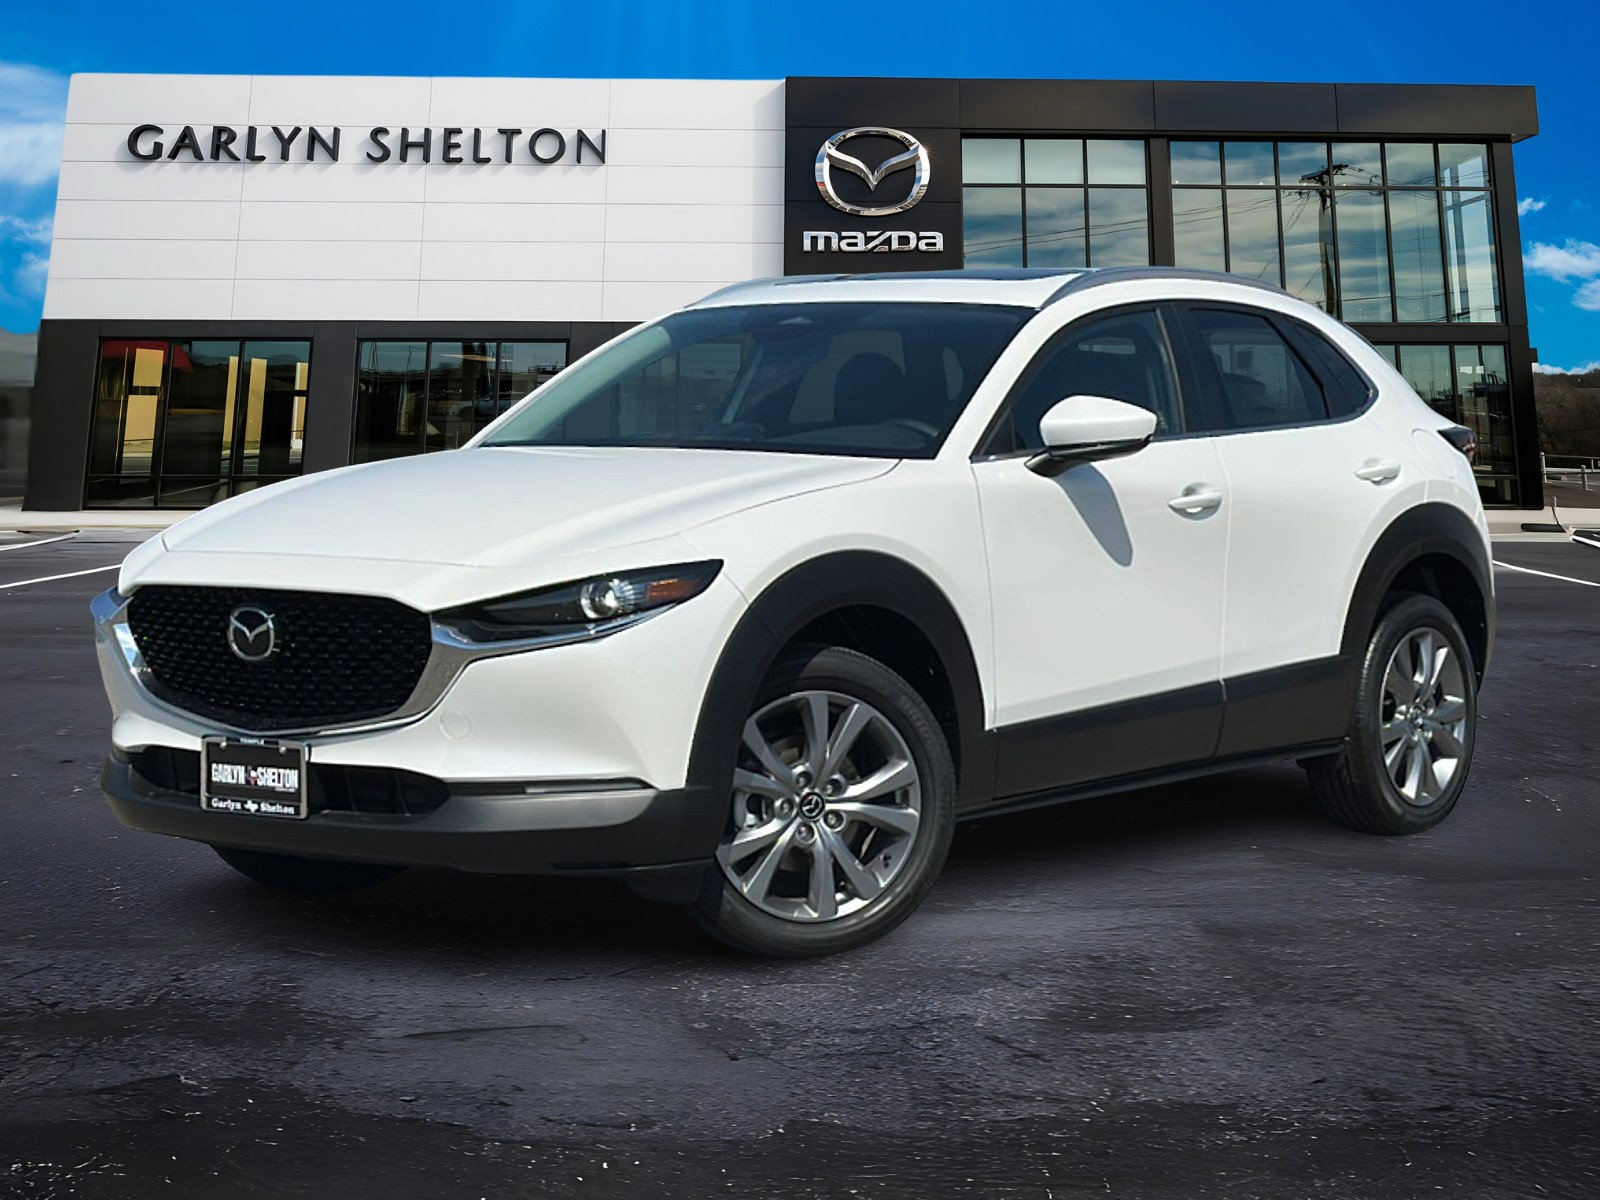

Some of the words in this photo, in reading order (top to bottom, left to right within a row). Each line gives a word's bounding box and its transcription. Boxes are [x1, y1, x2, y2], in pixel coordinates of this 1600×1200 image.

[127, 124, 341, 161] GARLYN
[366, 126, 606, 165] SHELTON
[256, 766, 298, 788] SHELTON
[211, 798, 241, 811] Garlyn
[260, 802, 294, 815] Shelton
